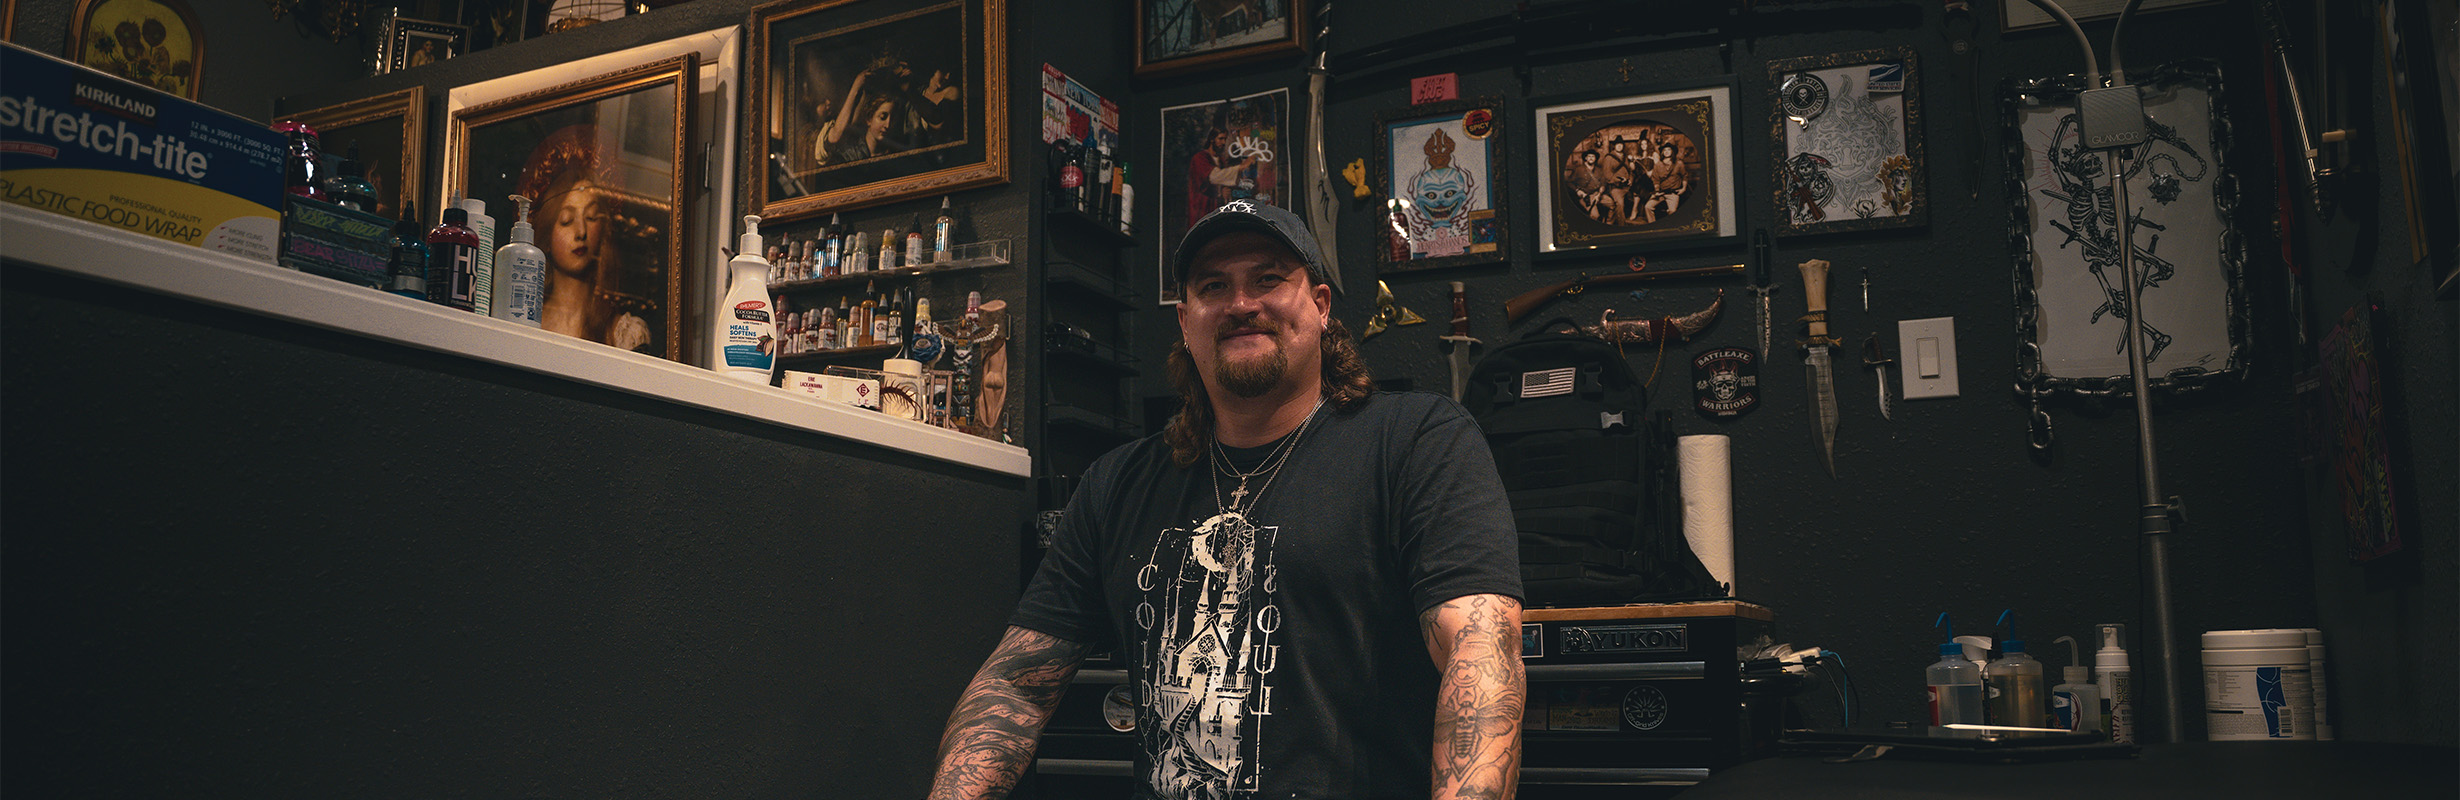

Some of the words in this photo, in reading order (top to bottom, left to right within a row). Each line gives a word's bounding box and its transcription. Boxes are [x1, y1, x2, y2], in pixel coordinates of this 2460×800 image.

[75, 82, 156, 118] KIRKLAND
[0, 94, 209, 180] stretch-tite
[1468, 121, 1490, 133] SPICY
[0, 178, 82, 214] PLASTIC
[82, 200, 140, 228] FOOD
[145, 217, 202, 243] WRAP
[109, 194, 167, 216] PROFESSIONAL
[169, 209, 203, 225] QUALITY
[1698, 351, 1751, 366] BATTLEAXE
[1702, 395, 1752, 411] WARRIORS
[1594, 630, 1682, 649] YUKON
